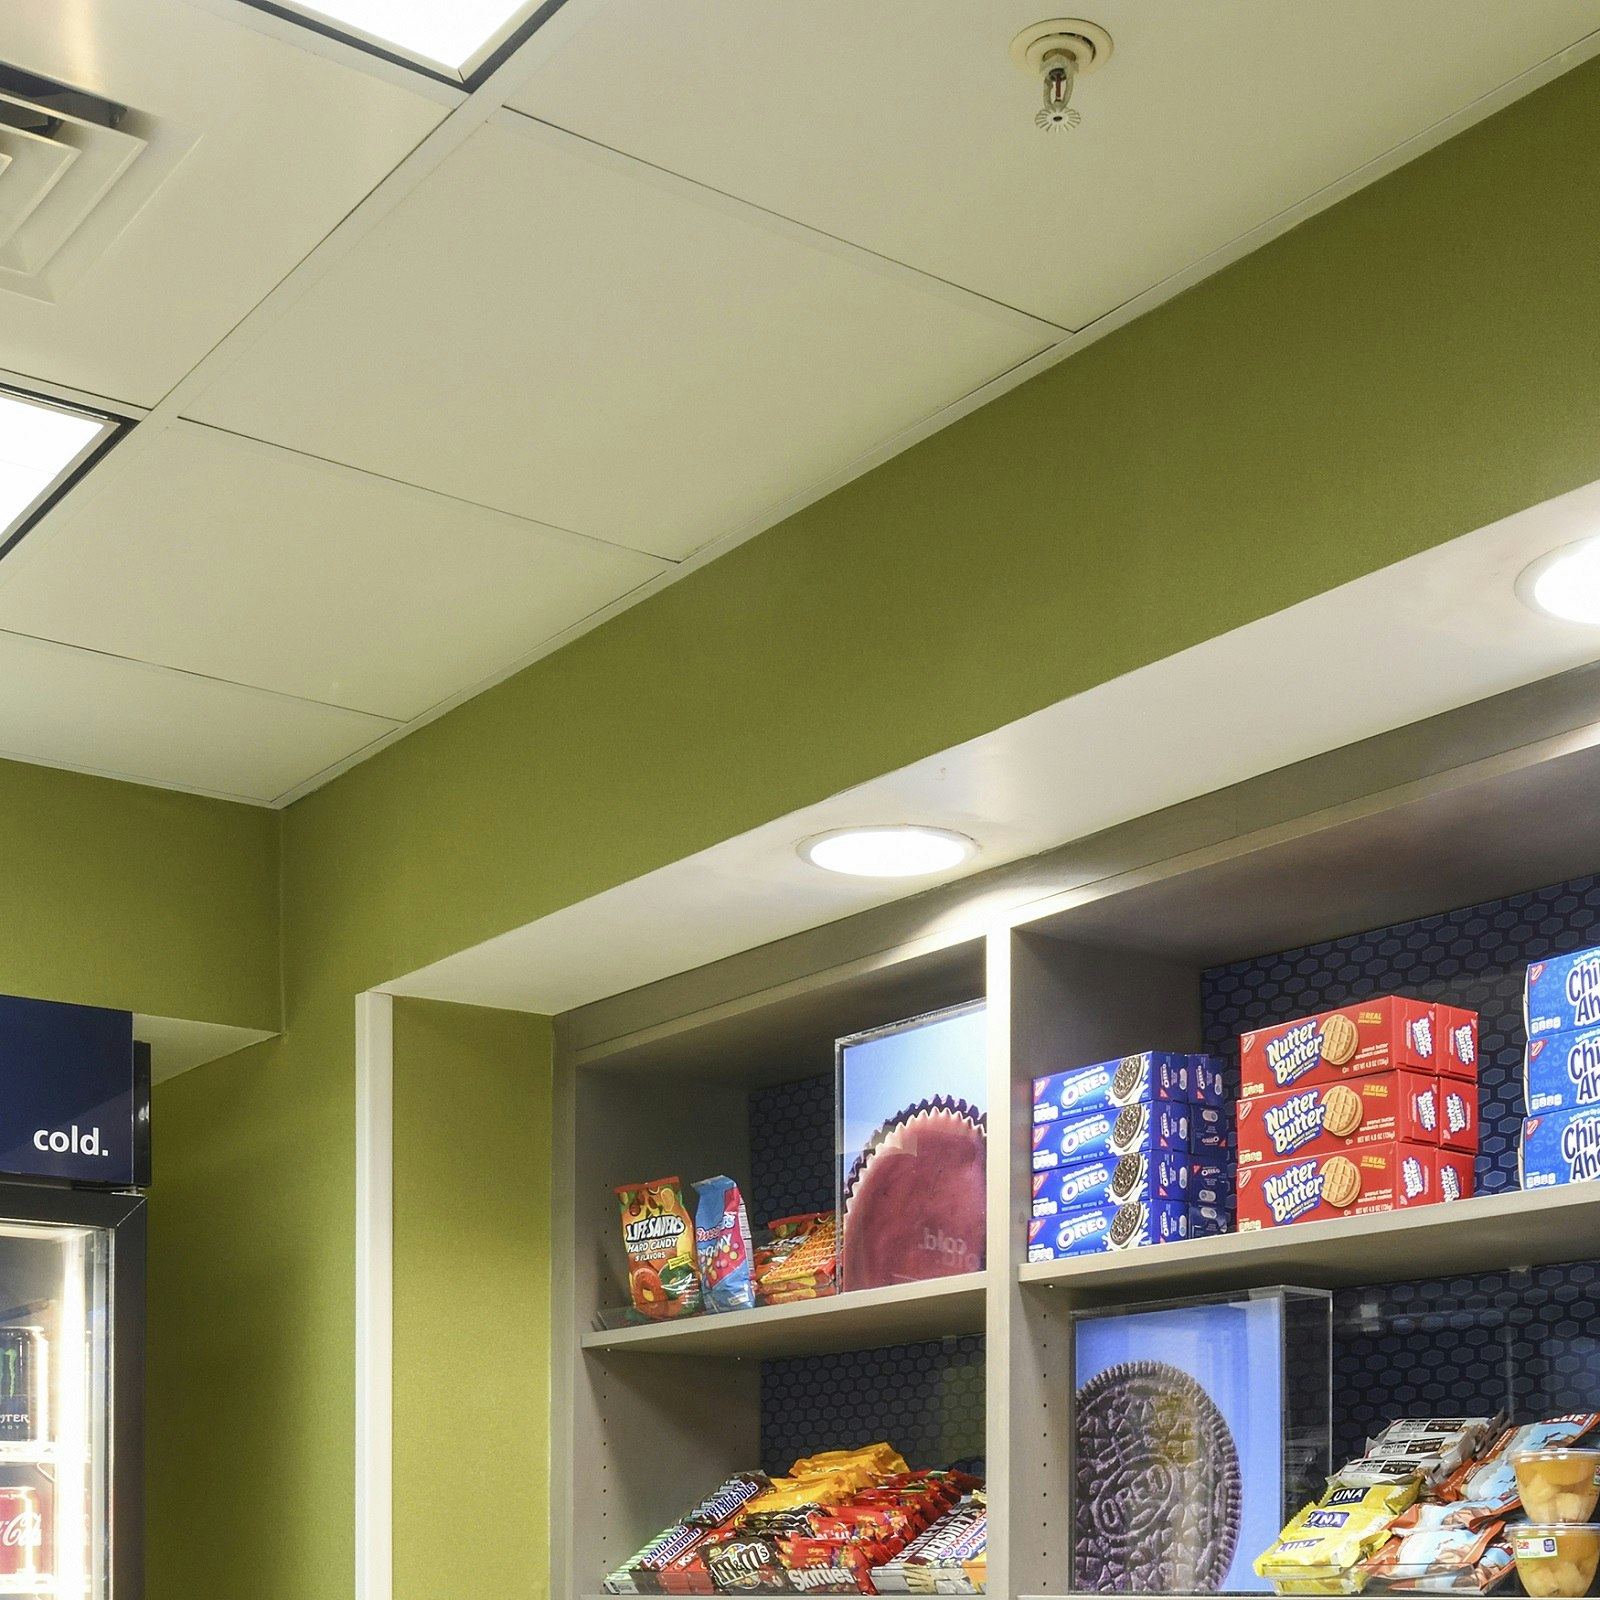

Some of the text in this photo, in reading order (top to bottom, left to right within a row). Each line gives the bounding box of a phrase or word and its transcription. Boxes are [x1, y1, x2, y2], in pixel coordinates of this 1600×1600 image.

[1365, 1012, 1382, 1020] REAL
[1266, 1020, 1317, 1067] Nutter
[1276, 1034, 1324, 1086] Butter
[1060, 1071, 1110, 1110] OREO
[1370, 1084, 1388, 1093] REAL
[1264, 1090, 1319, 1136] Nutter
[1273, 1104, 1325, 1155] Butter
[32, 1125, 109, 1157] cold.
[1060, 1119, 1110, 1156] OREO
[1368, 1155, 1386, 1164] REAL
[1060, 1169, 1109, 1204] OREO
[1264, 1160, 1317, 1206] Nutter
[1271, 1175, 1325, 1224] Butter
[627, 1237, 679, 1253] HARD CANDY
[1056, 1216, 1108, 1250] OREO
[640, 1251, 666, 1262] FLAVORS
[642, 1525, 689, 1566] SNICKERS
[656, 1527, 702, 1566] STUBBORN
[787, 1561, 857, 1593] Skittles
